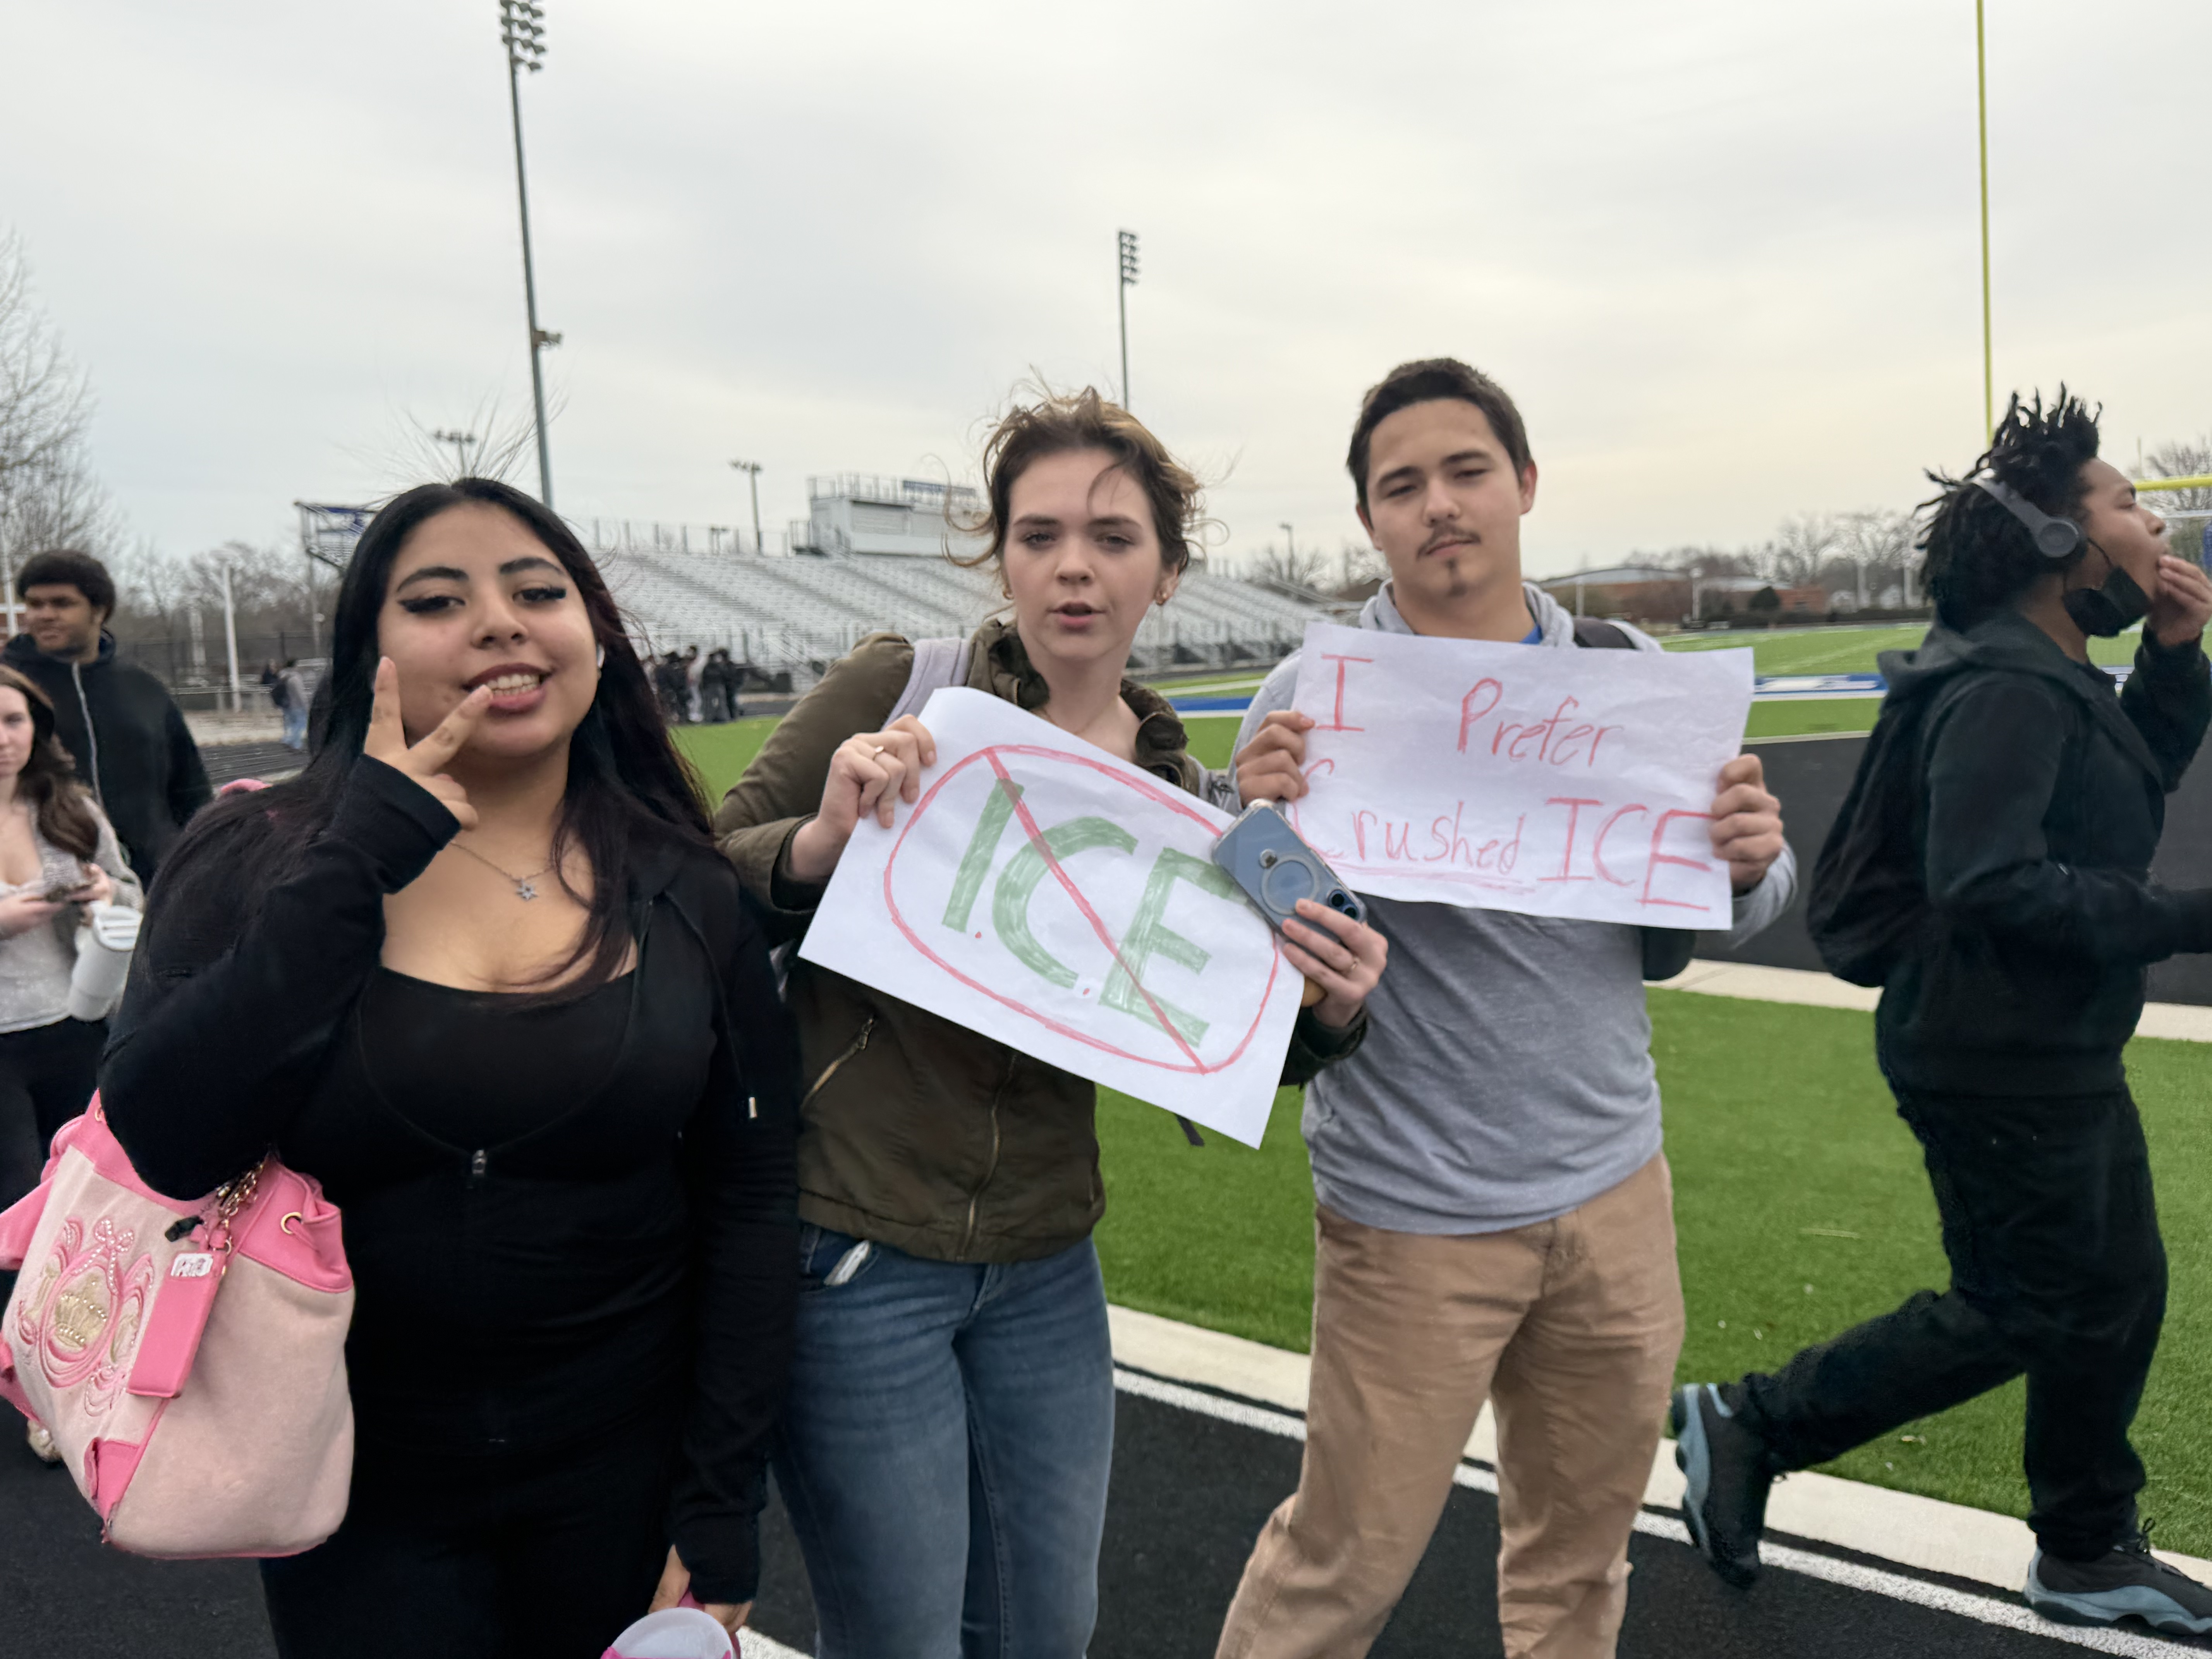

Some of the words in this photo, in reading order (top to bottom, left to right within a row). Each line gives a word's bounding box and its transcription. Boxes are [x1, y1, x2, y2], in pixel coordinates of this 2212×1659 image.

[1317, 654, 1374, 733] I
[1458, 677, 1623, 767] Prefer
[1291, 758, 1526, 874] Crushed
[1538, 797, 1715, 911] ICE
